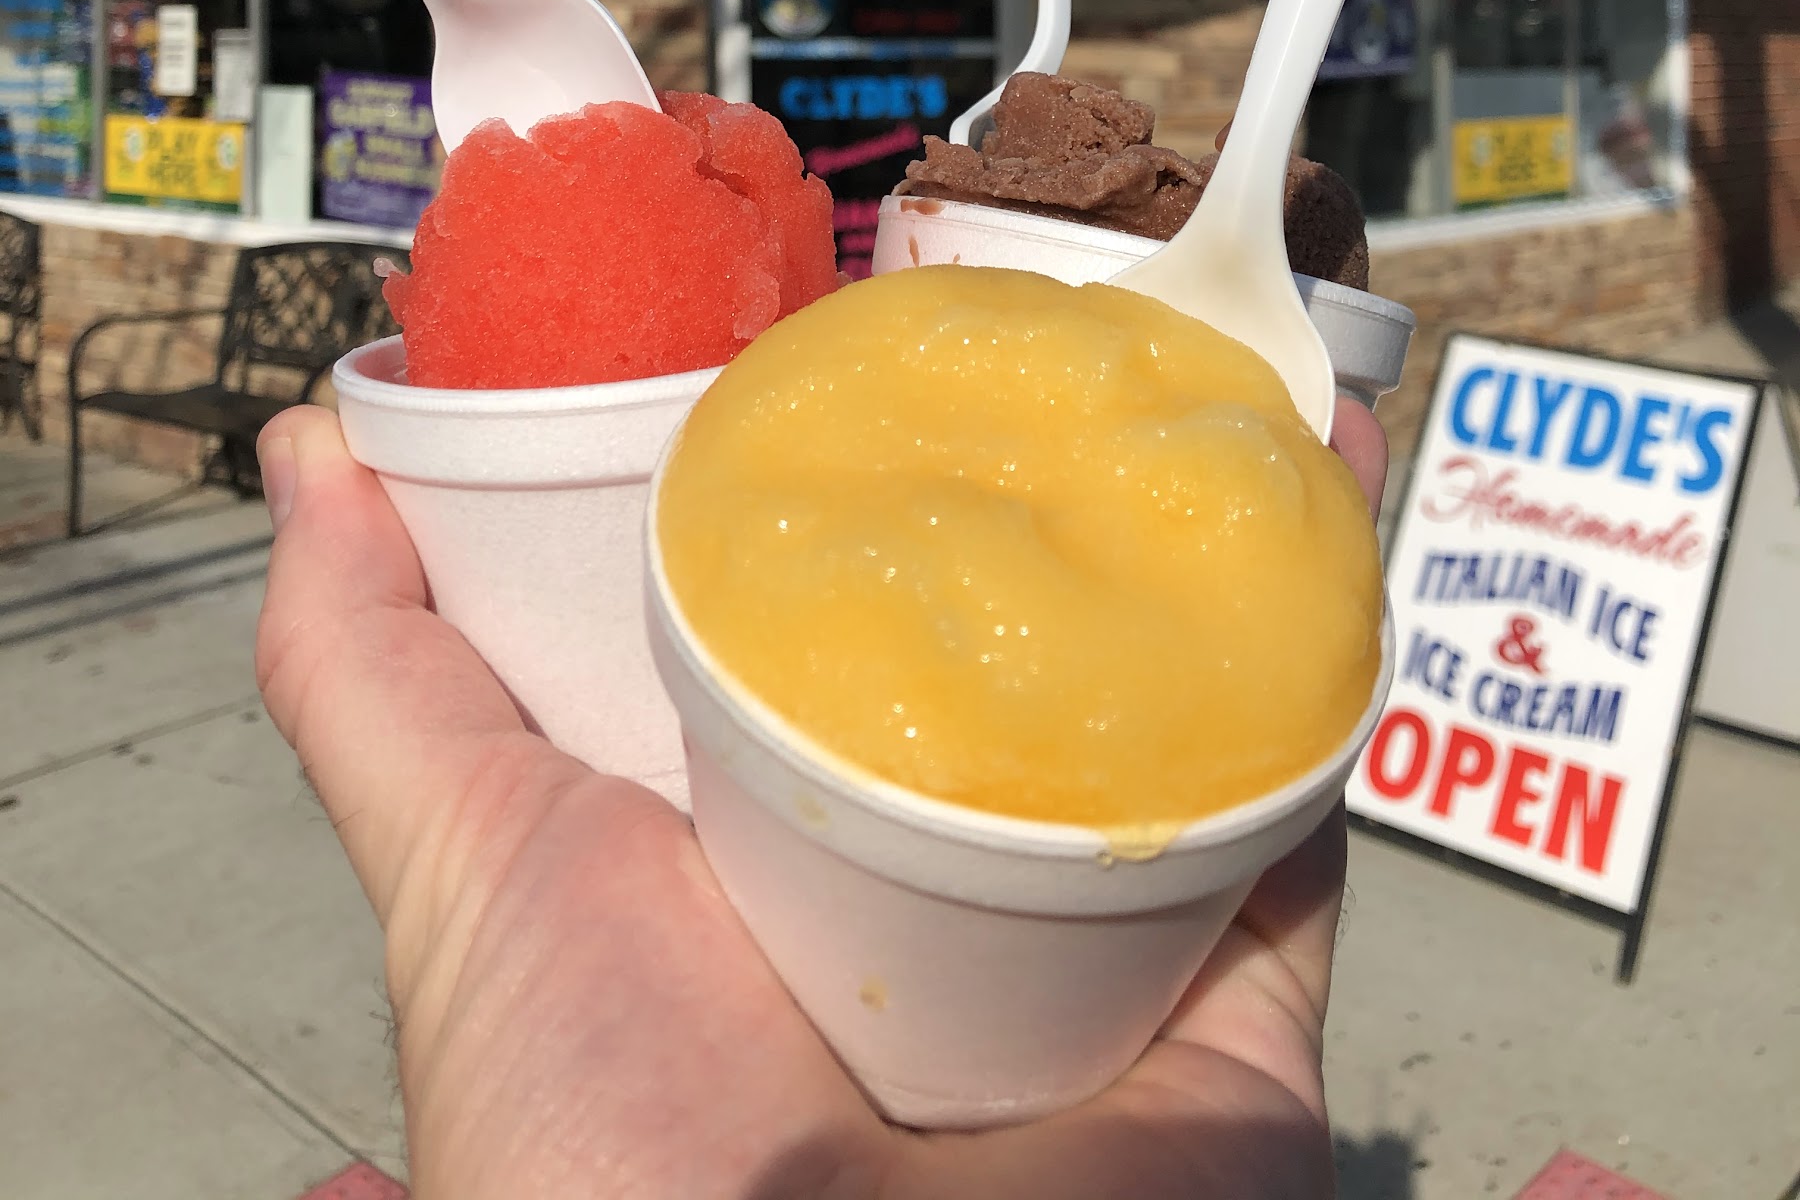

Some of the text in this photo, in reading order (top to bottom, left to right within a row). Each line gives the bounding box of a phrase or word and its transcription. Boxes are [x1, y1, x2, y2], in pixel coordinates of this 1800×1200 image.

[1449, 364, 1731, 494] CLYDE'S
[1422, 455, 1706, 569] Homemade
[1416, 549, 1662, 664] ITALIAN ICE
[1497, 616, 1545, 674] &
[1403, 629, 1624, 743] ICE CREAM
[1366, 708, 1627, 876] OPEN
